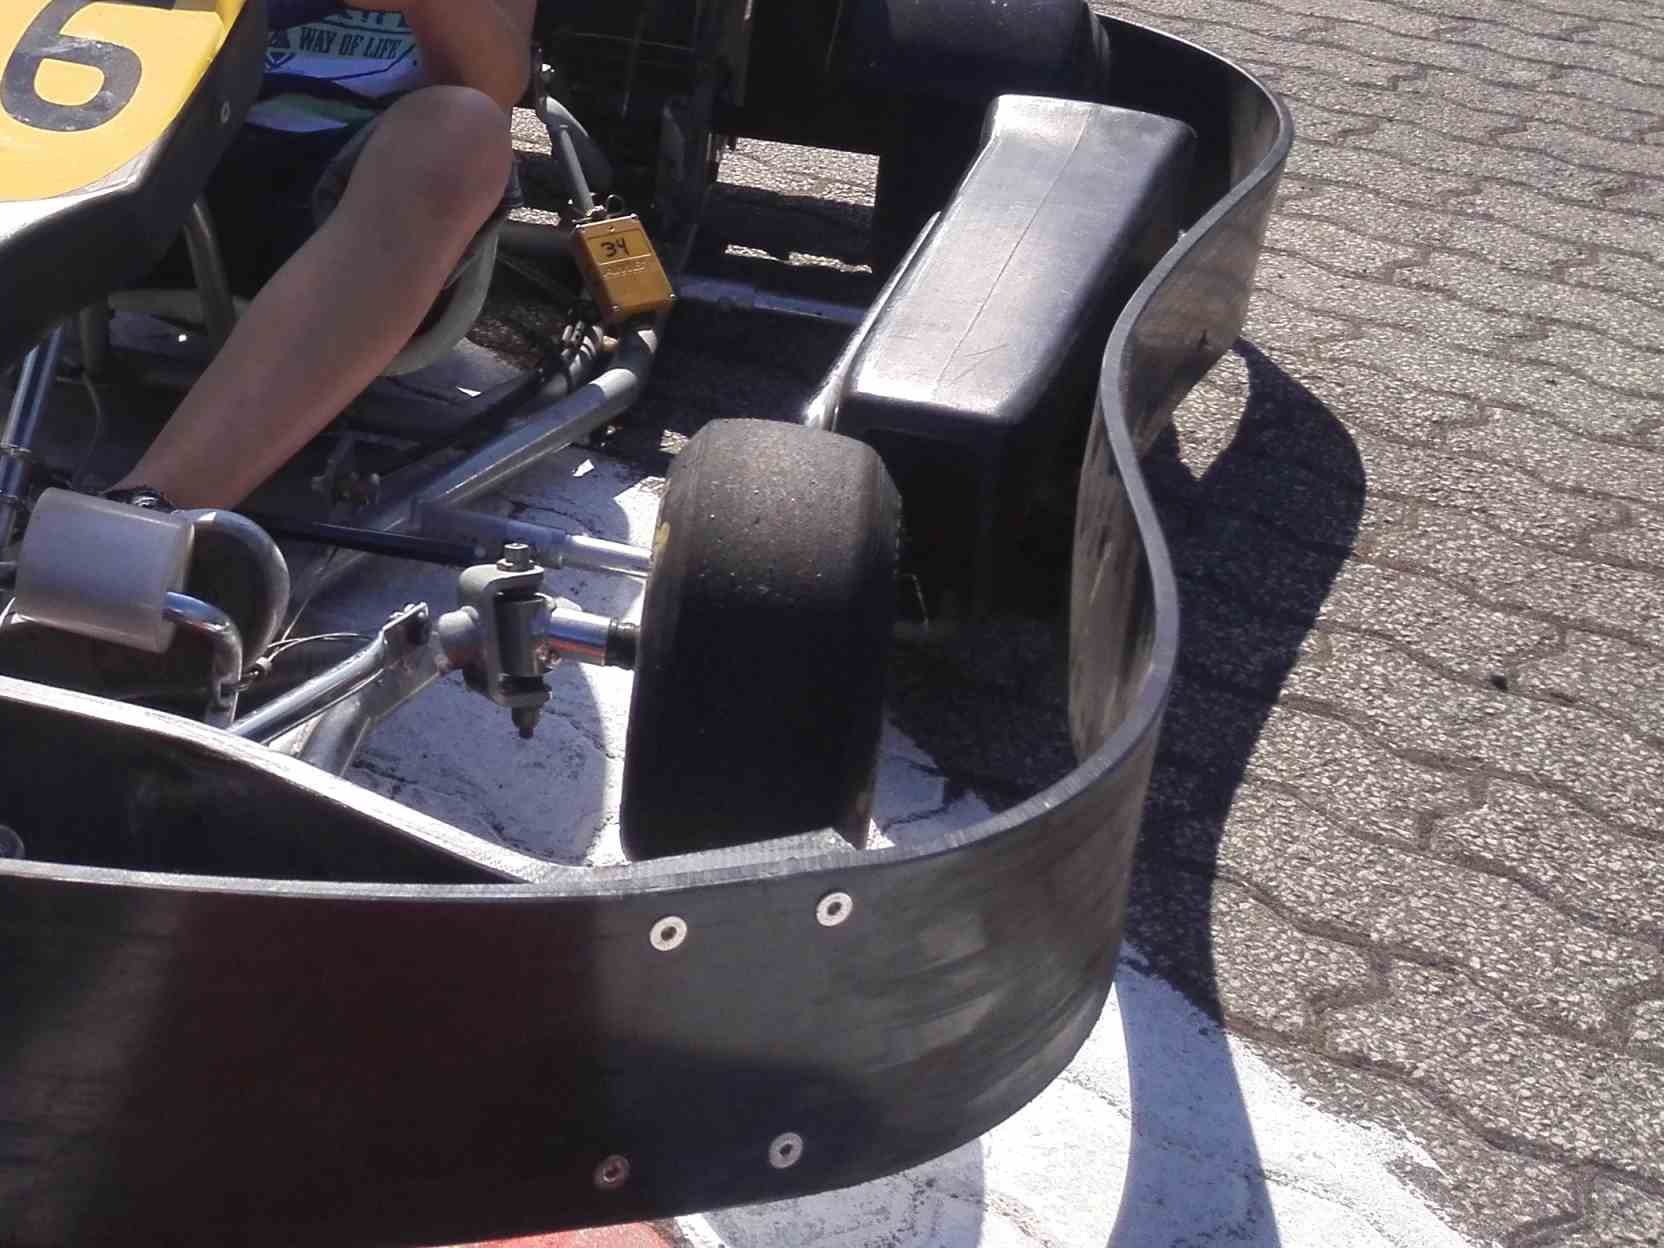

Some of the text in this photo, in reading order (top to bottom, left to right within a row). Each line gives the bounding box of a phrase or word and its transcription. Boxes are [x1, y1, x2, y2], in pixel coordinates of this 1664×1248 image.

[299, 27, 403, 61] WAY OF LIFE
[600, 237, 630, 258] 34
